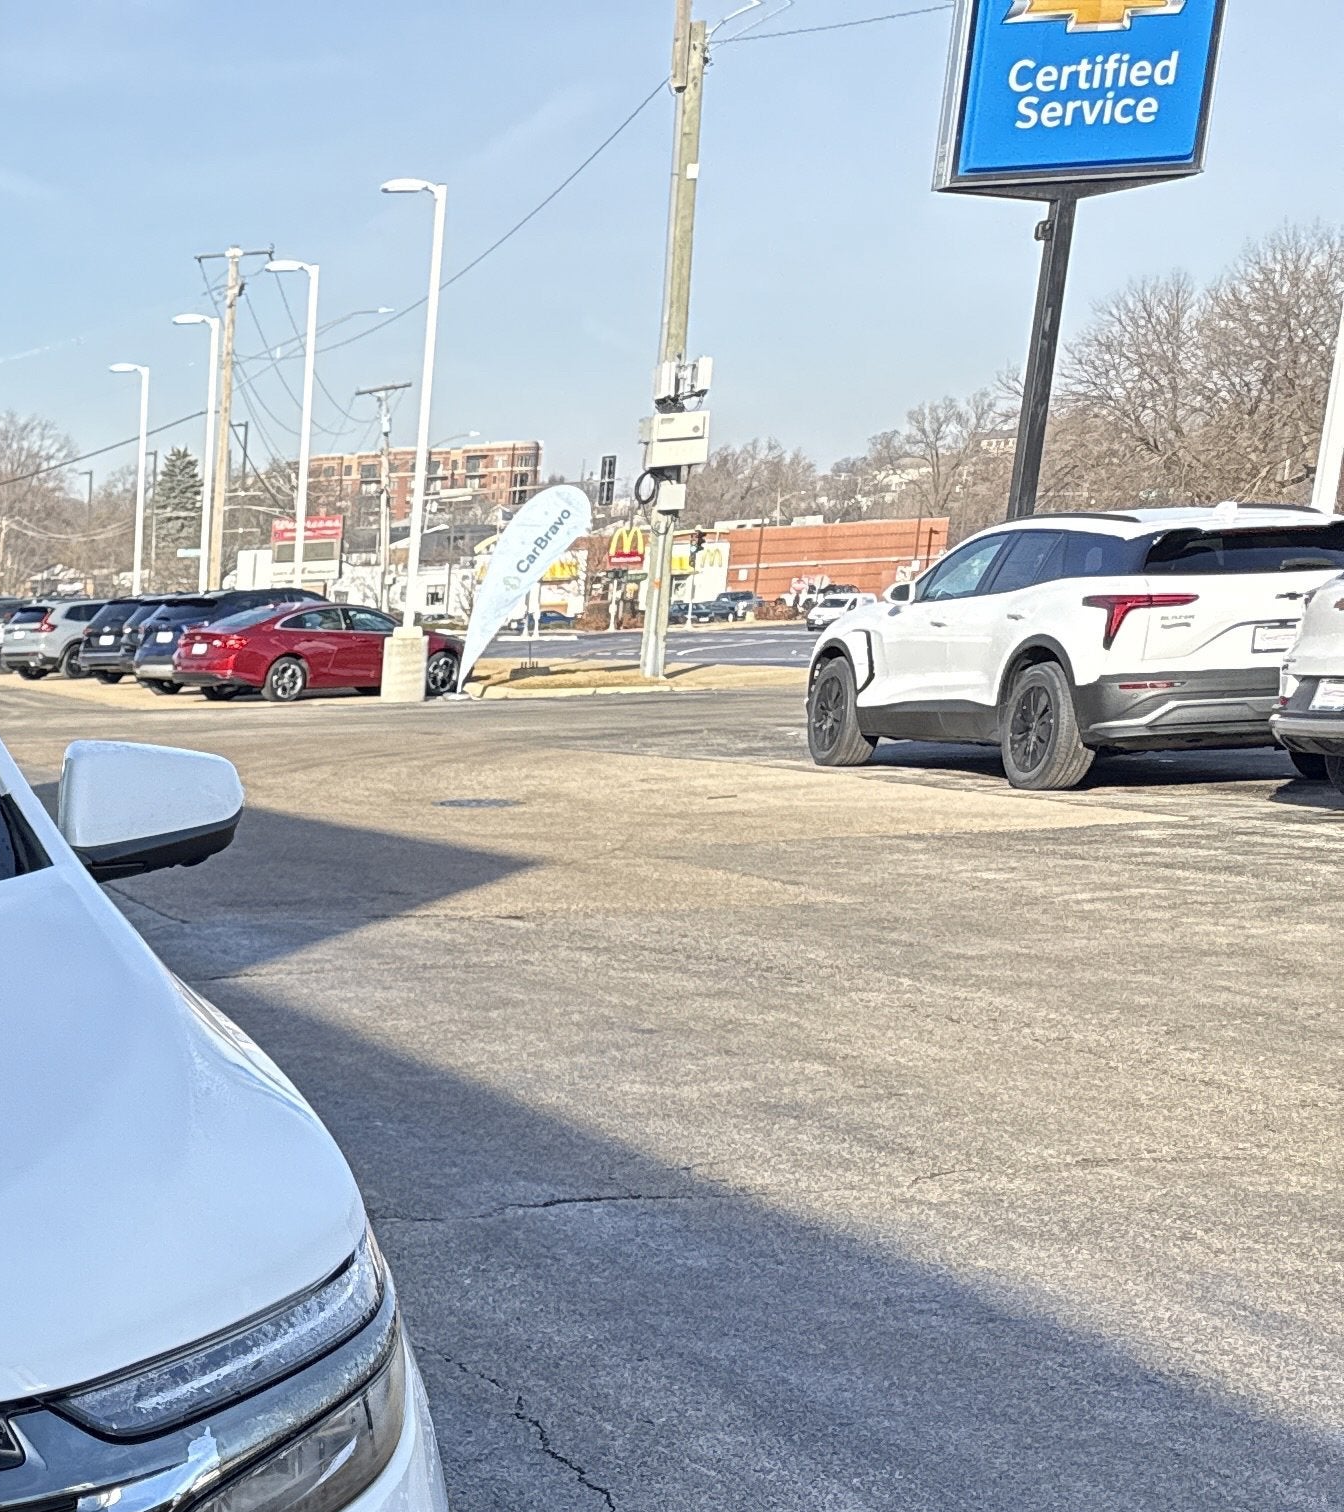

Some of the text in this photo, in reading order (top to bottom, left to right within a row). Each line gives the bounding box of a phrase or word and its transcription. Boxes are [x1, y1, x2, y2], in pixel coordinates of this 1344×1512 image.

[1008, 50, 1180, 92] Certified
[1014, 91, 1159, 130] Service
[516, 509, 571, 573] CarBravo
